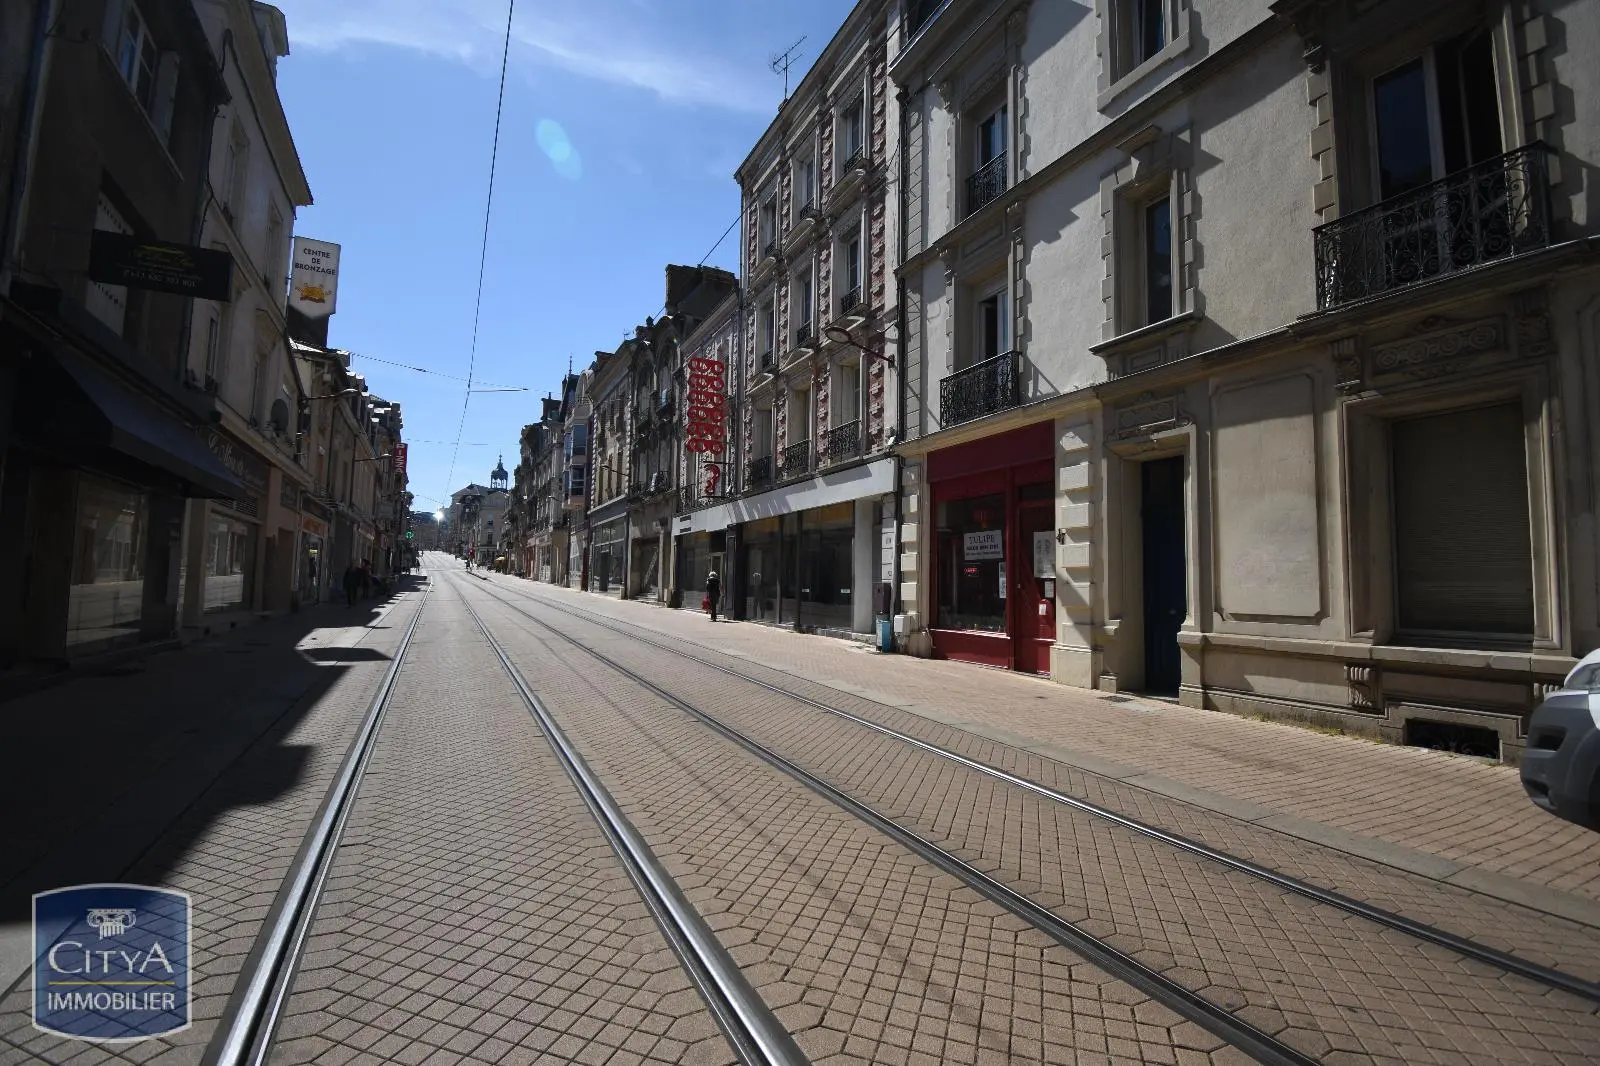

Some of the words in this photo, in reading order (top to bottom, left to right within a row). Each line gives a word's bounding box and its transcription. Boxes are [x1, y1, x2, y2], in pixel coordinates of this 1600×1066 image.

[303, 247, 331, 259] CENTRE
[311, 257, 321, 265] DE
[295, 262, 337, 276] BRONZAGE
